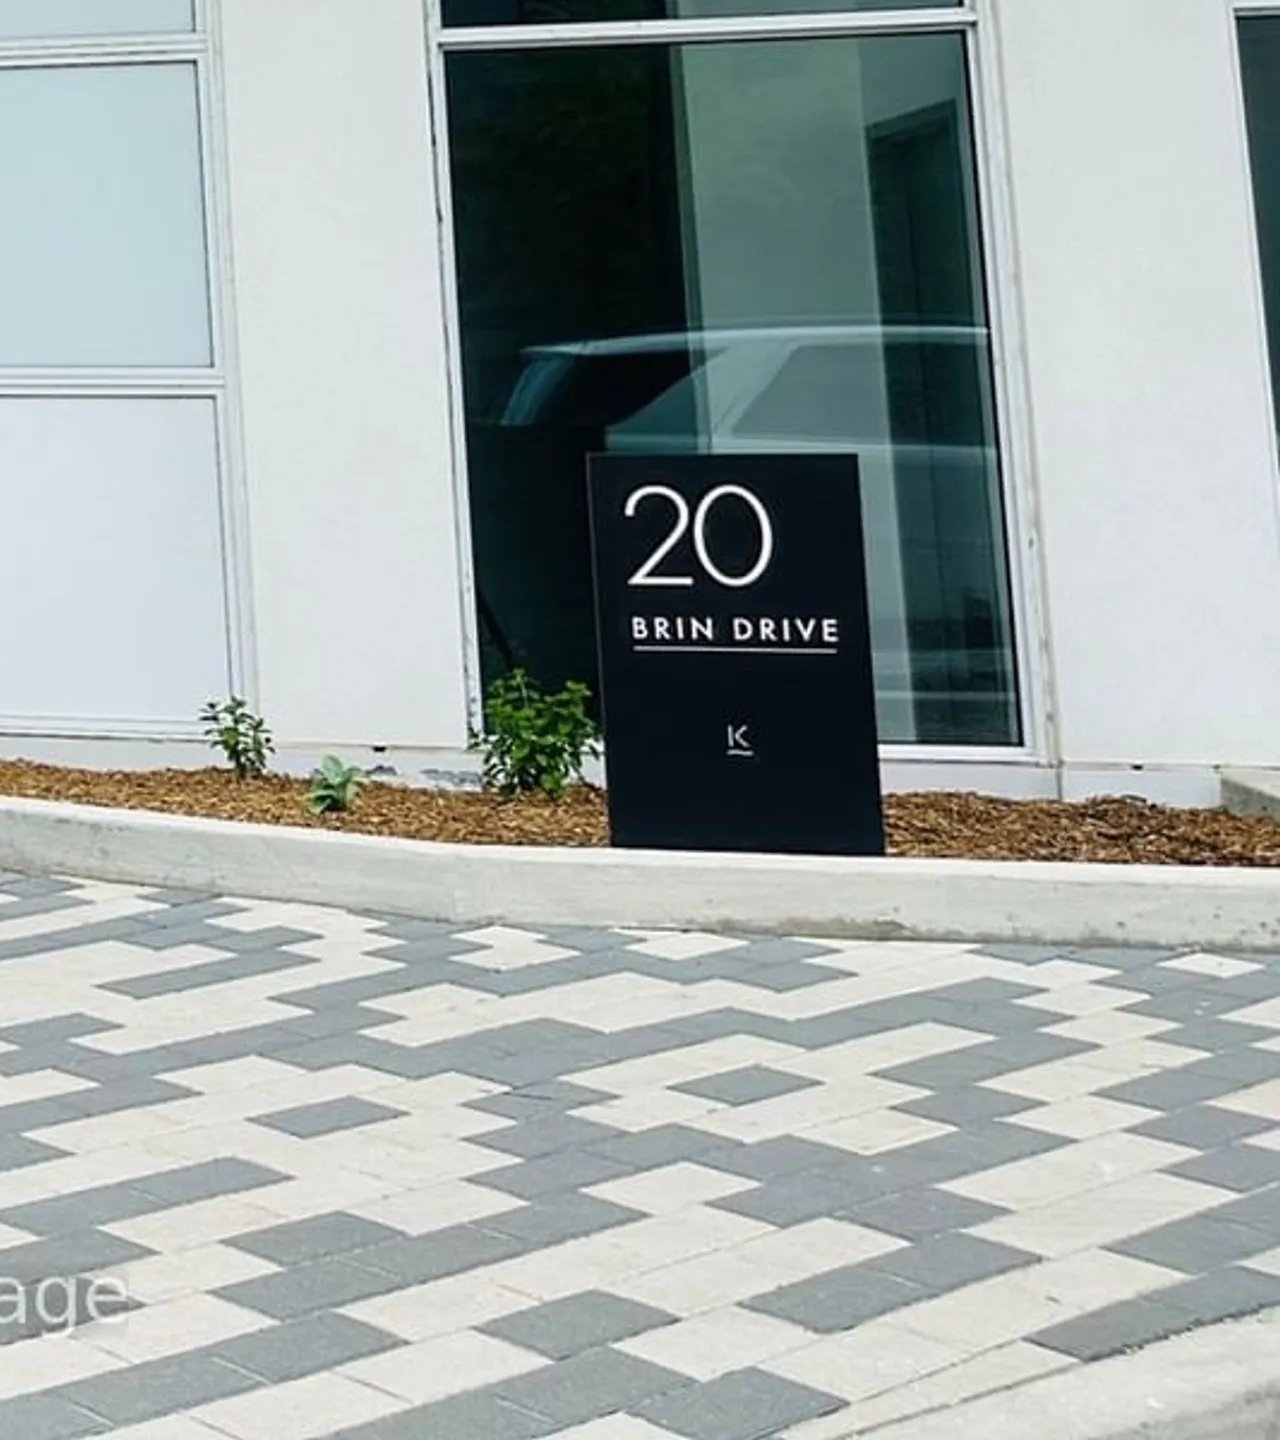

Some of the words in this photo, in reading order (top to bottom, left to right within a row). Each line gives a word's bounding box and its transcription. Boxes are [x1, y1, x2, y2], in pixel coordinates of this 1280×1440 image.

[624, 484, 773, 587] 20
[631, 616, 714, 640] BRIN
[732, 617, 840, 642] DRIVE
[726, 724, 751, 748] K
